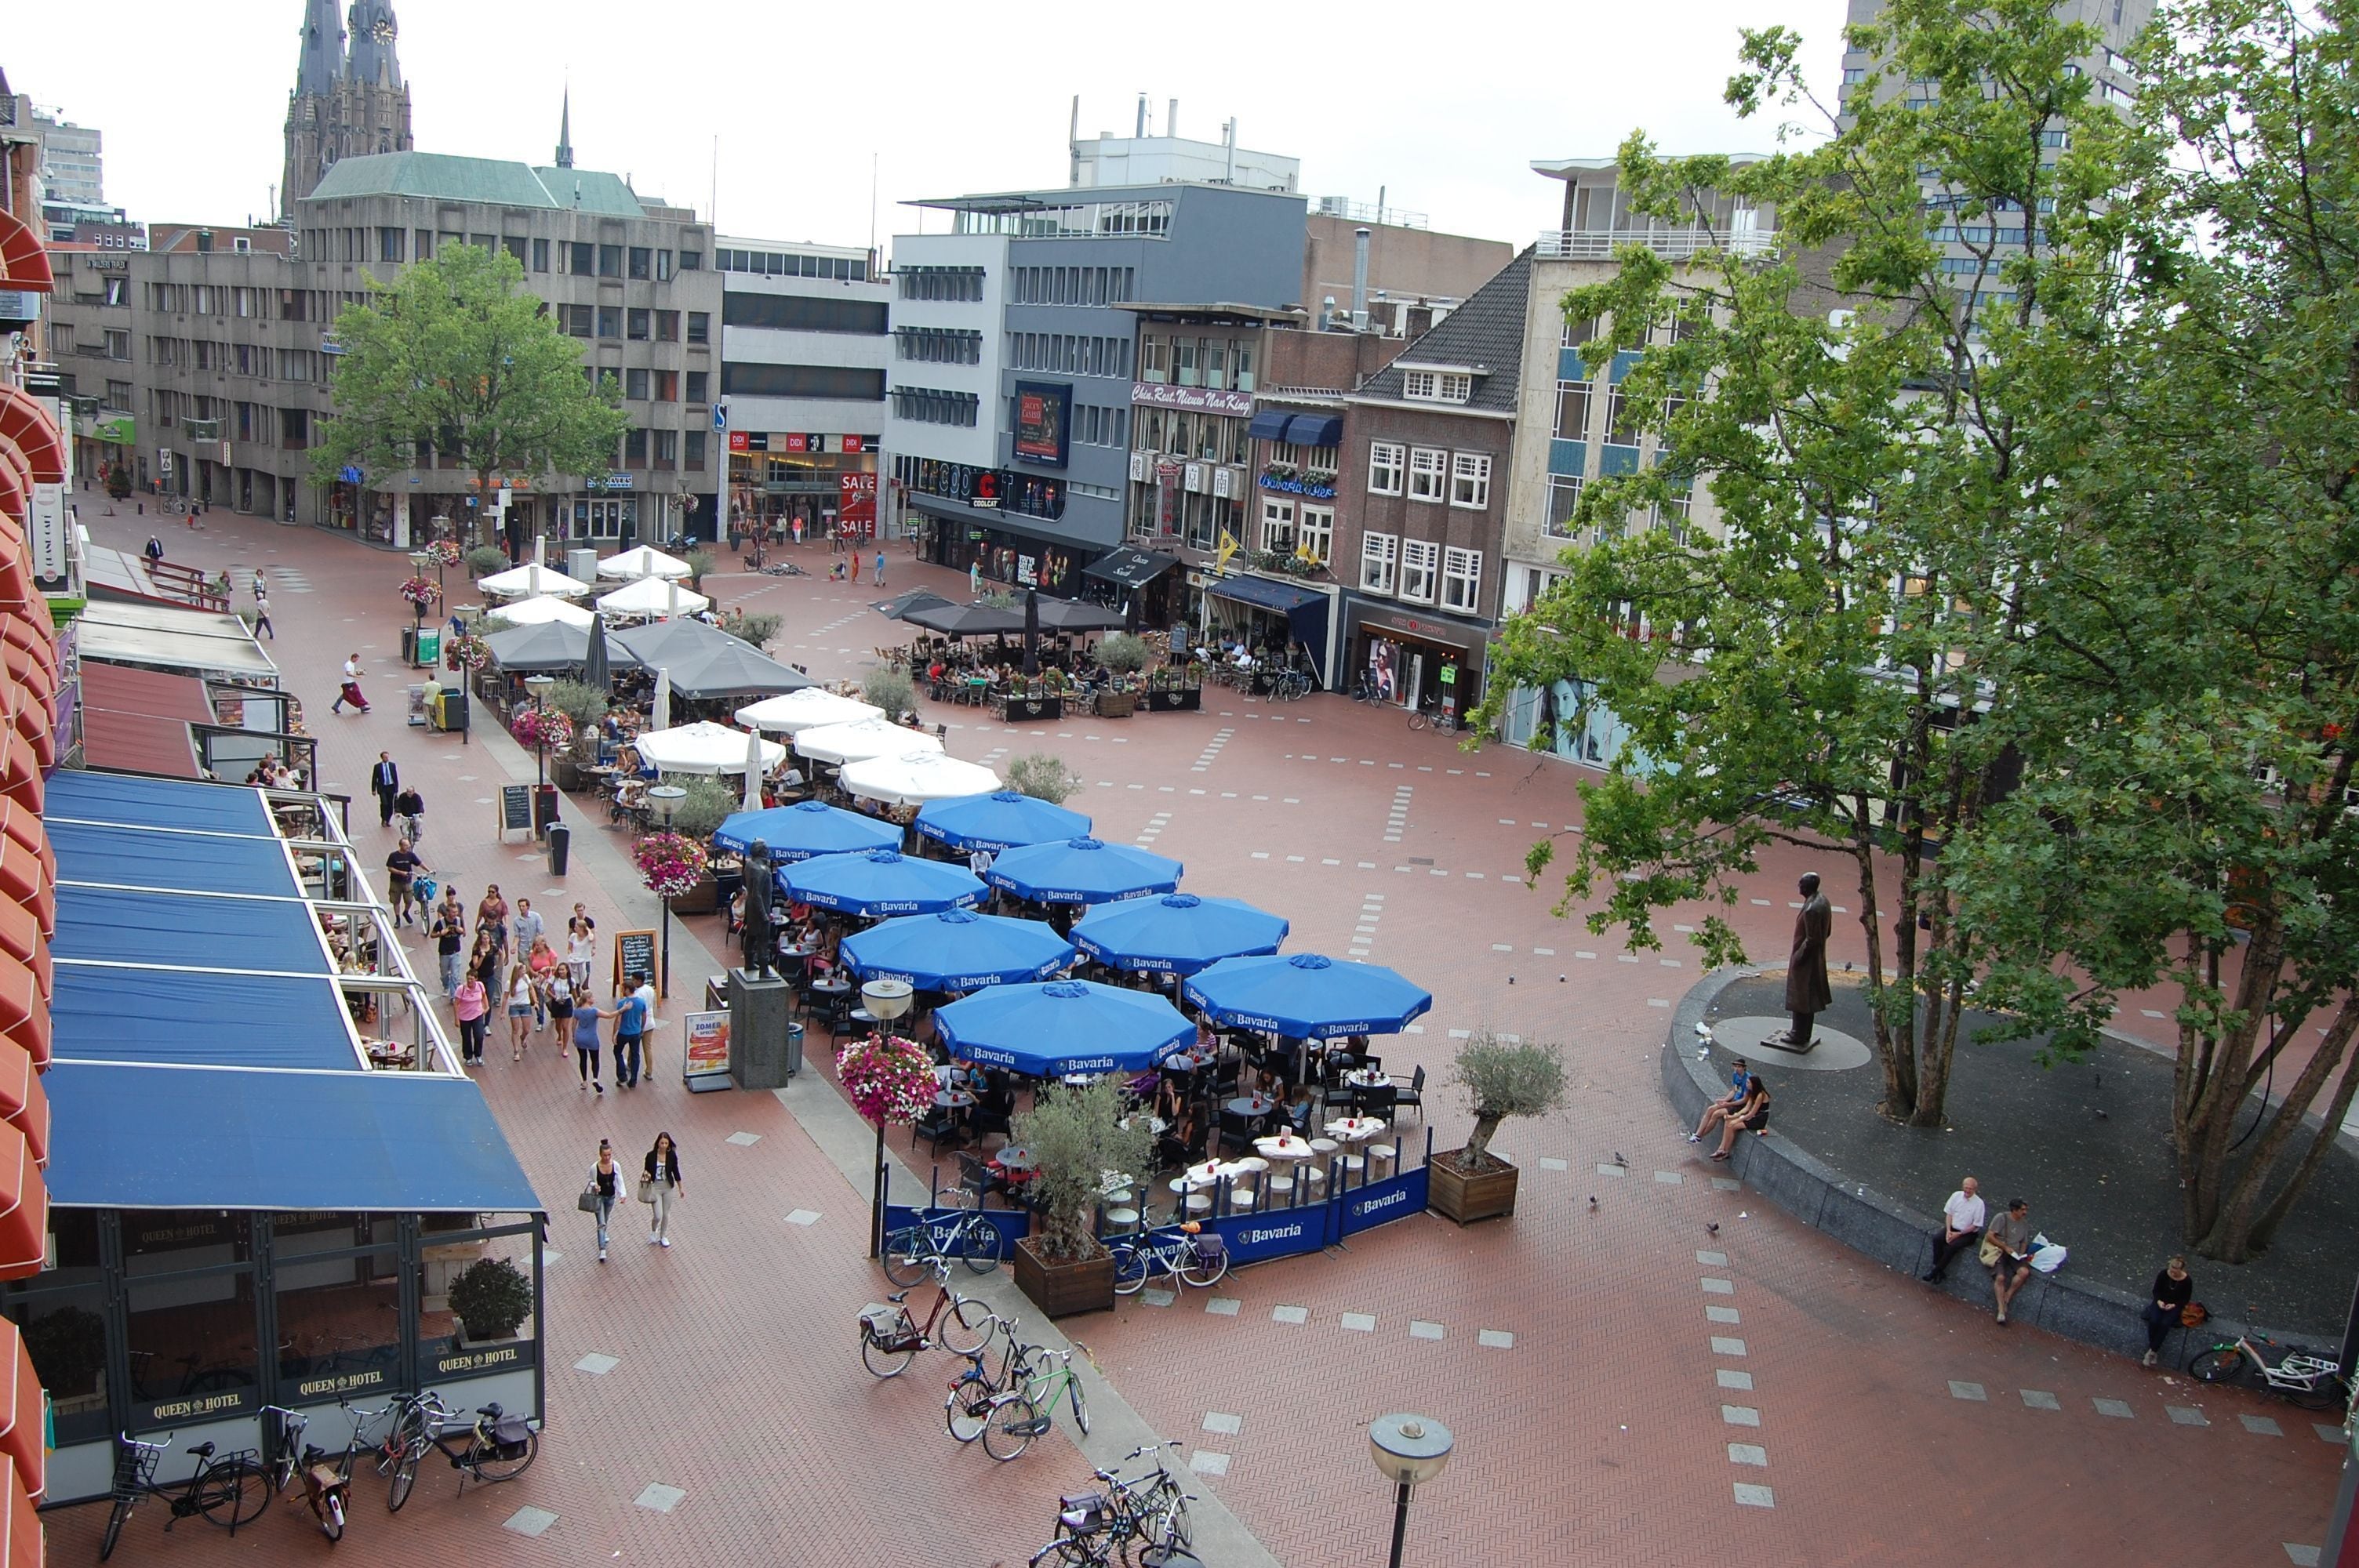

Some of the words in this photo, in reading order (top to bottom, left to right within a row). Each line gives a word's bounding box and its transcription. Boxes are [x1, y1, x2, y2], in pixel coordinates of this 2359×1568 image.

[1132, 385, 1154, 401] Chin.
[1154, 387, 1176, 403] Rest.
[1176, 389, 1205, 405] Nieuw
[1205, 391, 1226, 408] Nan
[1226, 394, 1250, 416] King
[717, 405, 726, 427] S
[732, 435, 744, 444] DIDI
[790, 438, 802, 447] DIDI
[842, 476, 874, 489] SALE
[980, 474, 994, 497] C
[1216, 472, 1227, 494] 南
[1259, 474, 1302, 494] Bavaria
[973, 499, 998, 508] COOLCAT
[841, 520, 872, 533] SALE
[924, 823, 945, 838] Bavaria
[722, 837, 744, 851] Bavaria
[976, 840, 1009, 850] Bavaria
[776, 850, 810, 859] Bavaria
[995, 876, 1016, 890] Bavaria
[806, 891, 838, 906] Bavaria
[1047, 891, 1084, 901] Bavaria
[1123, 887, 1152, 901] Bavaria
[881, 902, 918, 912] Bavaria
[1078, 938, 1100, 956] Bavaria
[1041, 957, 1060, 976] Bavaria
[1132, 958, 1172, 969] Bavaria
[878, 971, 914, 985] Bavaria
[960, 974, 1001, 988] Bavaria
[696, 1022, 722, 1031] ZOMER
[1236, 1014, 1278, 1030] Bavaria
[1329, 1022, 1369, 1035] Bavaria
[1158, 1037, 1180, 1059] Bavaria
[974, 1047, 1015, 1065] Bavaria
[1068, 1055, 1114, 1071] Bavaria
[1364, 1189, 1406, 1214] Bavaria
[1252, 1223, 1301, 1243] Bavaria
[438, 1356, 472, 1373] QUEEN
[485, 1348, 518, 1365] HOTEL
[300, 1377, 336, 1396] QUEEN
[348, 1370, 383, 1387] HOTEL
[154, 1401, 191, 1420] QUEEN
[205, 1393, 242, 1410] HOTEL
